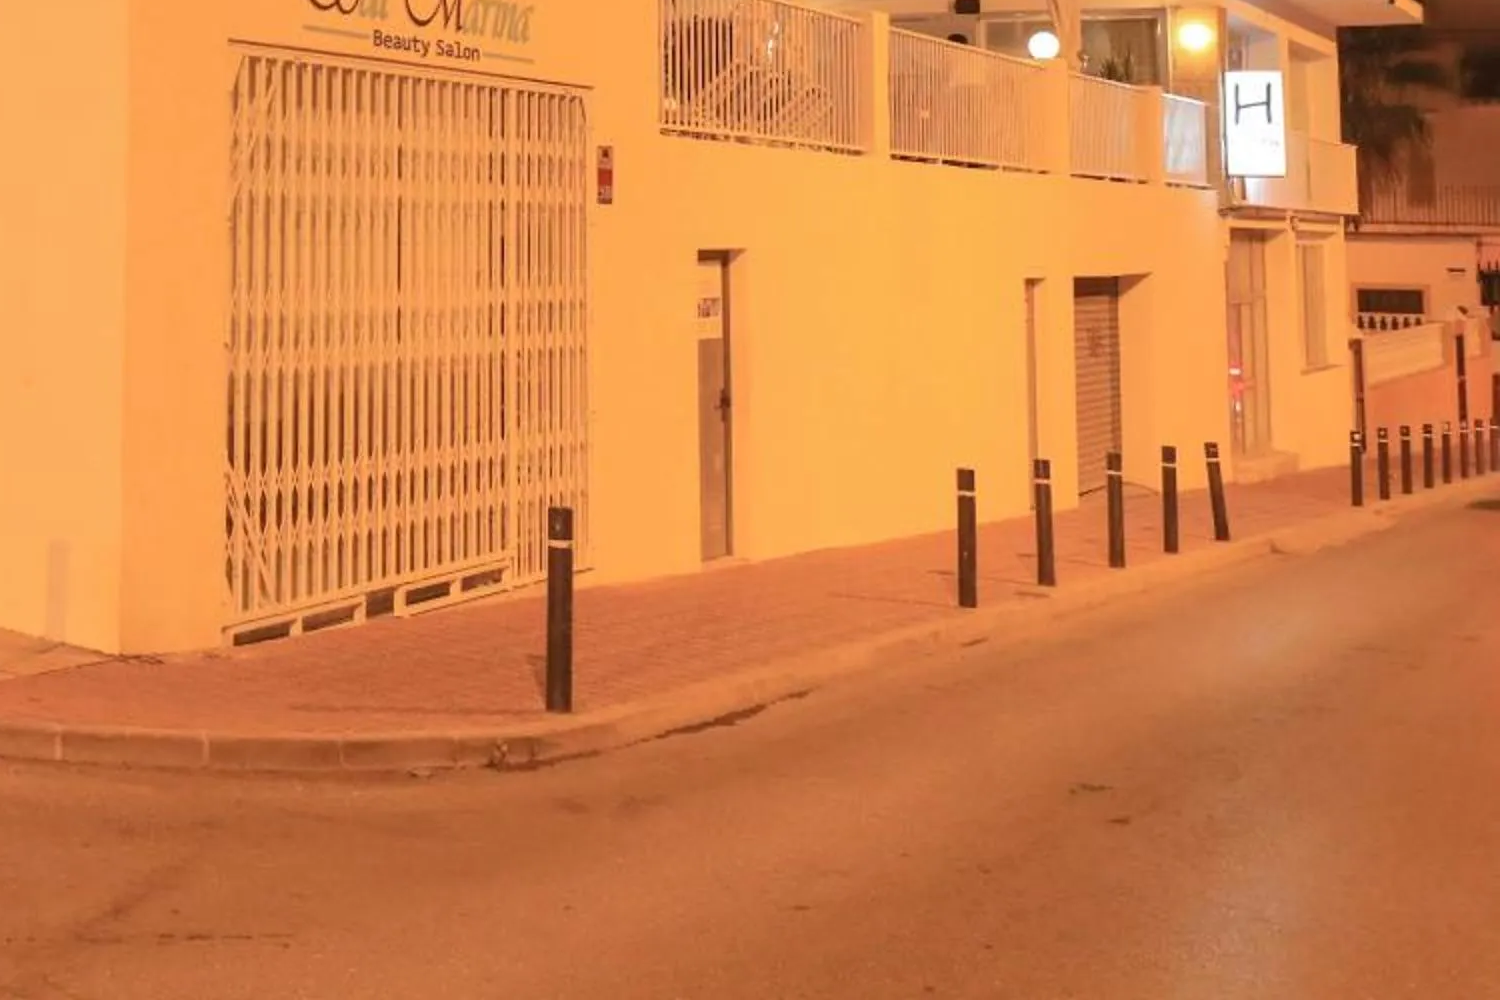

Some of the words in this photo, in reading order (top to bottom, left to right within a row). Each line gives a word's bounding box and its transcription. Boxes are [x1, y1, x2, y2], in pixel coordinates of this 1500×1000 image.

[373, 29, 430, 57] Beauty
[436, 39, 481, 61] Salon
[1234, 81, 1273, 126] H
